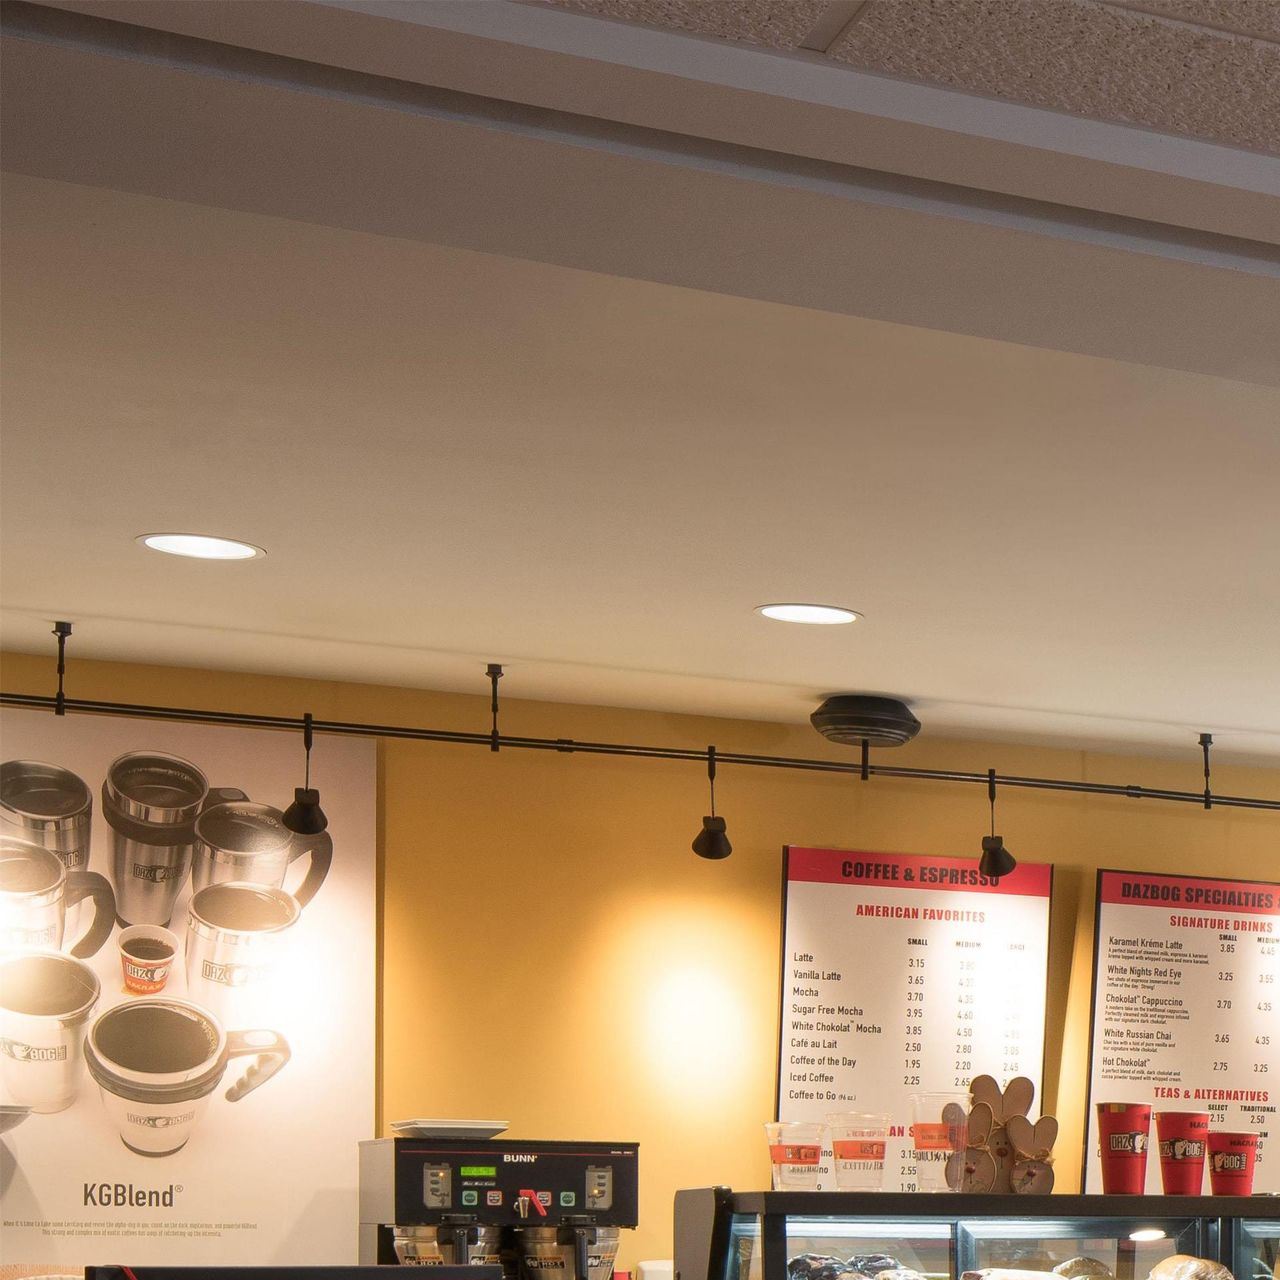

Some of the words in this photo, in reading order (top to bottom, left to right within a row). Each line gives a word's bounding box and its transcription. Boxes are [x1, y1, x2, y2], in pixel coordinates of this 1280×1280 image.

[842, 861, 899, 880] COFFEE
[904, 868, 915, 881] &
[920, 867, 999, 887] ESPRESSO
[1122, 883, 1181, 902] DAZBOG
[1185, 888, 1273, 909] SPECIALTIES
[856, 905, 918, 919] AMERICAN
[922, 909, 986, 923] FAVORITES
[1170, 916, 1230, 930] SIGNATURE
[1233, 921, 1272, 933] DRINKS
[908, 938, 928, 946] SMALL
[1109, 936, 1138, 947] Karamel
[1166, 940, 1182, 950] Latte
[1219, 934, 1237, 942] SMALL
[794, 953, 813, 962] Latte
[908, 959, 924, 968] 3.15
[204, 962, 225, 982] DAZ
[794, 970, 820, 980] Vanilla
[822, 972, 841, 981] Latte
[1108, 965, 1127, 974] White
[1130, 966, 1152, 977] Nights
[1154, 968, 1167, 977] Red
[1170, 970, 1181, 979] Eye
[1218, 972, 1234, 981] 3.25
[793, 988, 818, 996] Mocha
[1142, 996, 1183, 1007] Cappuccino
[792, 1004, 816, 1016] Sugar
[818, 1005, 835, 1015] Free
[838, 1006, 863, 1016] Mocha
[792, 1022, 814, 1030] White
[856, 1024, 882, 1034] Mocha
[1105, 1028, 1124, 1038] White
[1126, 1030, 1154, 1039] Russian
[1156, 1031, 1171, 1040] Chai
[1215, 1034, 1230, 1043] 3.65
[791, 1038, 808, 1048] Café
[822, 1040, 837, 1048] Lait
[31, 1048, 55, 1060] BOG
[790, 1056, 815, 1065] Coffee
[826, 1057, 840, 1066] the
[842, 1057, 856, 1068] Day
[1103, 1056, 1114, 1066] Hot
[1214, 1062, 1228, 1071] 2.75
[1254, 1064, 1268, 1072] 3.25
[790, 1073, 806, 1082] Iced
[809, 1073, 834, 1082] Coffee
[904, 1076, 920, 1085] 2.25
[789, 1090, 814, 1100] Coffee
[826, 1090, 836, 1100] Go
[1153, 1087, 1180, 1098] TEAS
[1193, 1089, 1268, 1103] ALTERNATIVES
[1250, 1116, 1264, 1124] 2.50
[1111, 1134, 1129, 1151] DAZ
[1185, 1143, 1200, 1156] BOG
[1224, 1154, 1240, 1169] BOG
